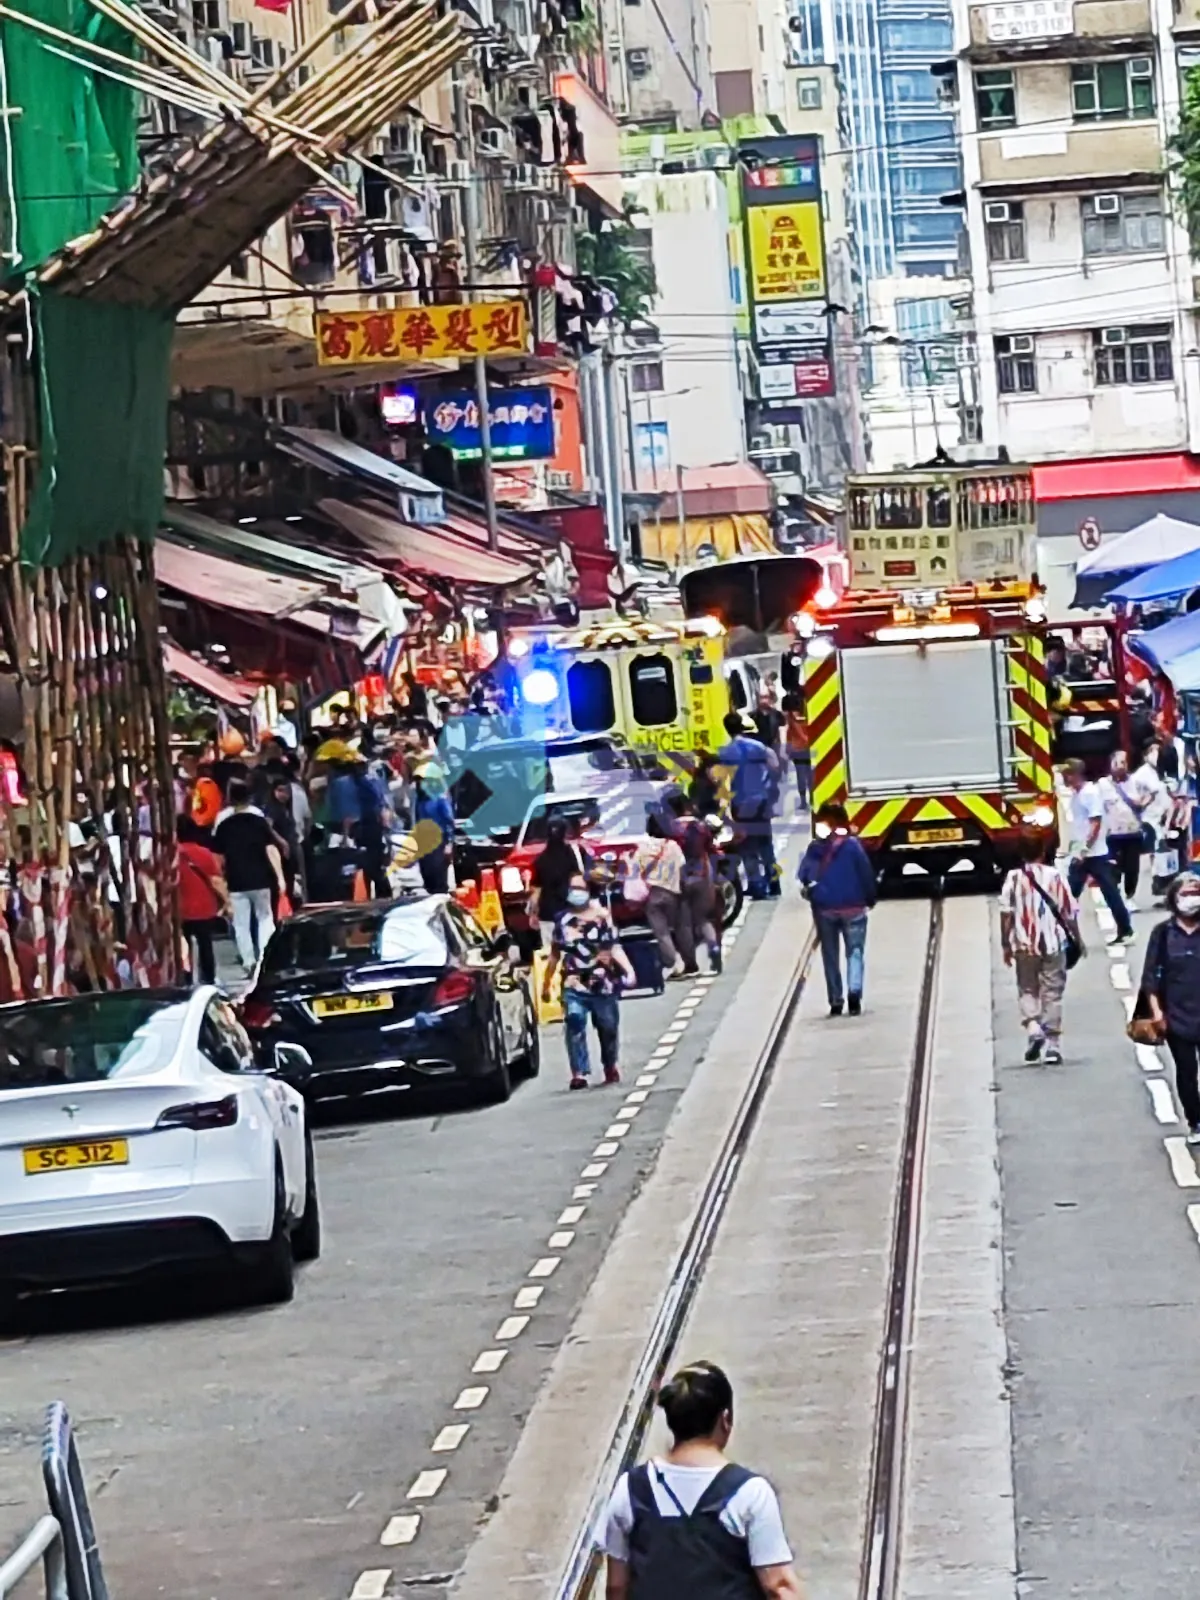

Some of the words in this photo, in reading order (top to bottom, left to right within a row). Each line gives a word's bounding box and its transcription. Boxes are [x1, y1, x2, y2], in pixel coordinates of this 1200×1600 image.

[319, 305, 522, 360] 富麗華髮型
[38, 1149, 68, 1168] SC
[77, 1144, 114, 1163] 312
